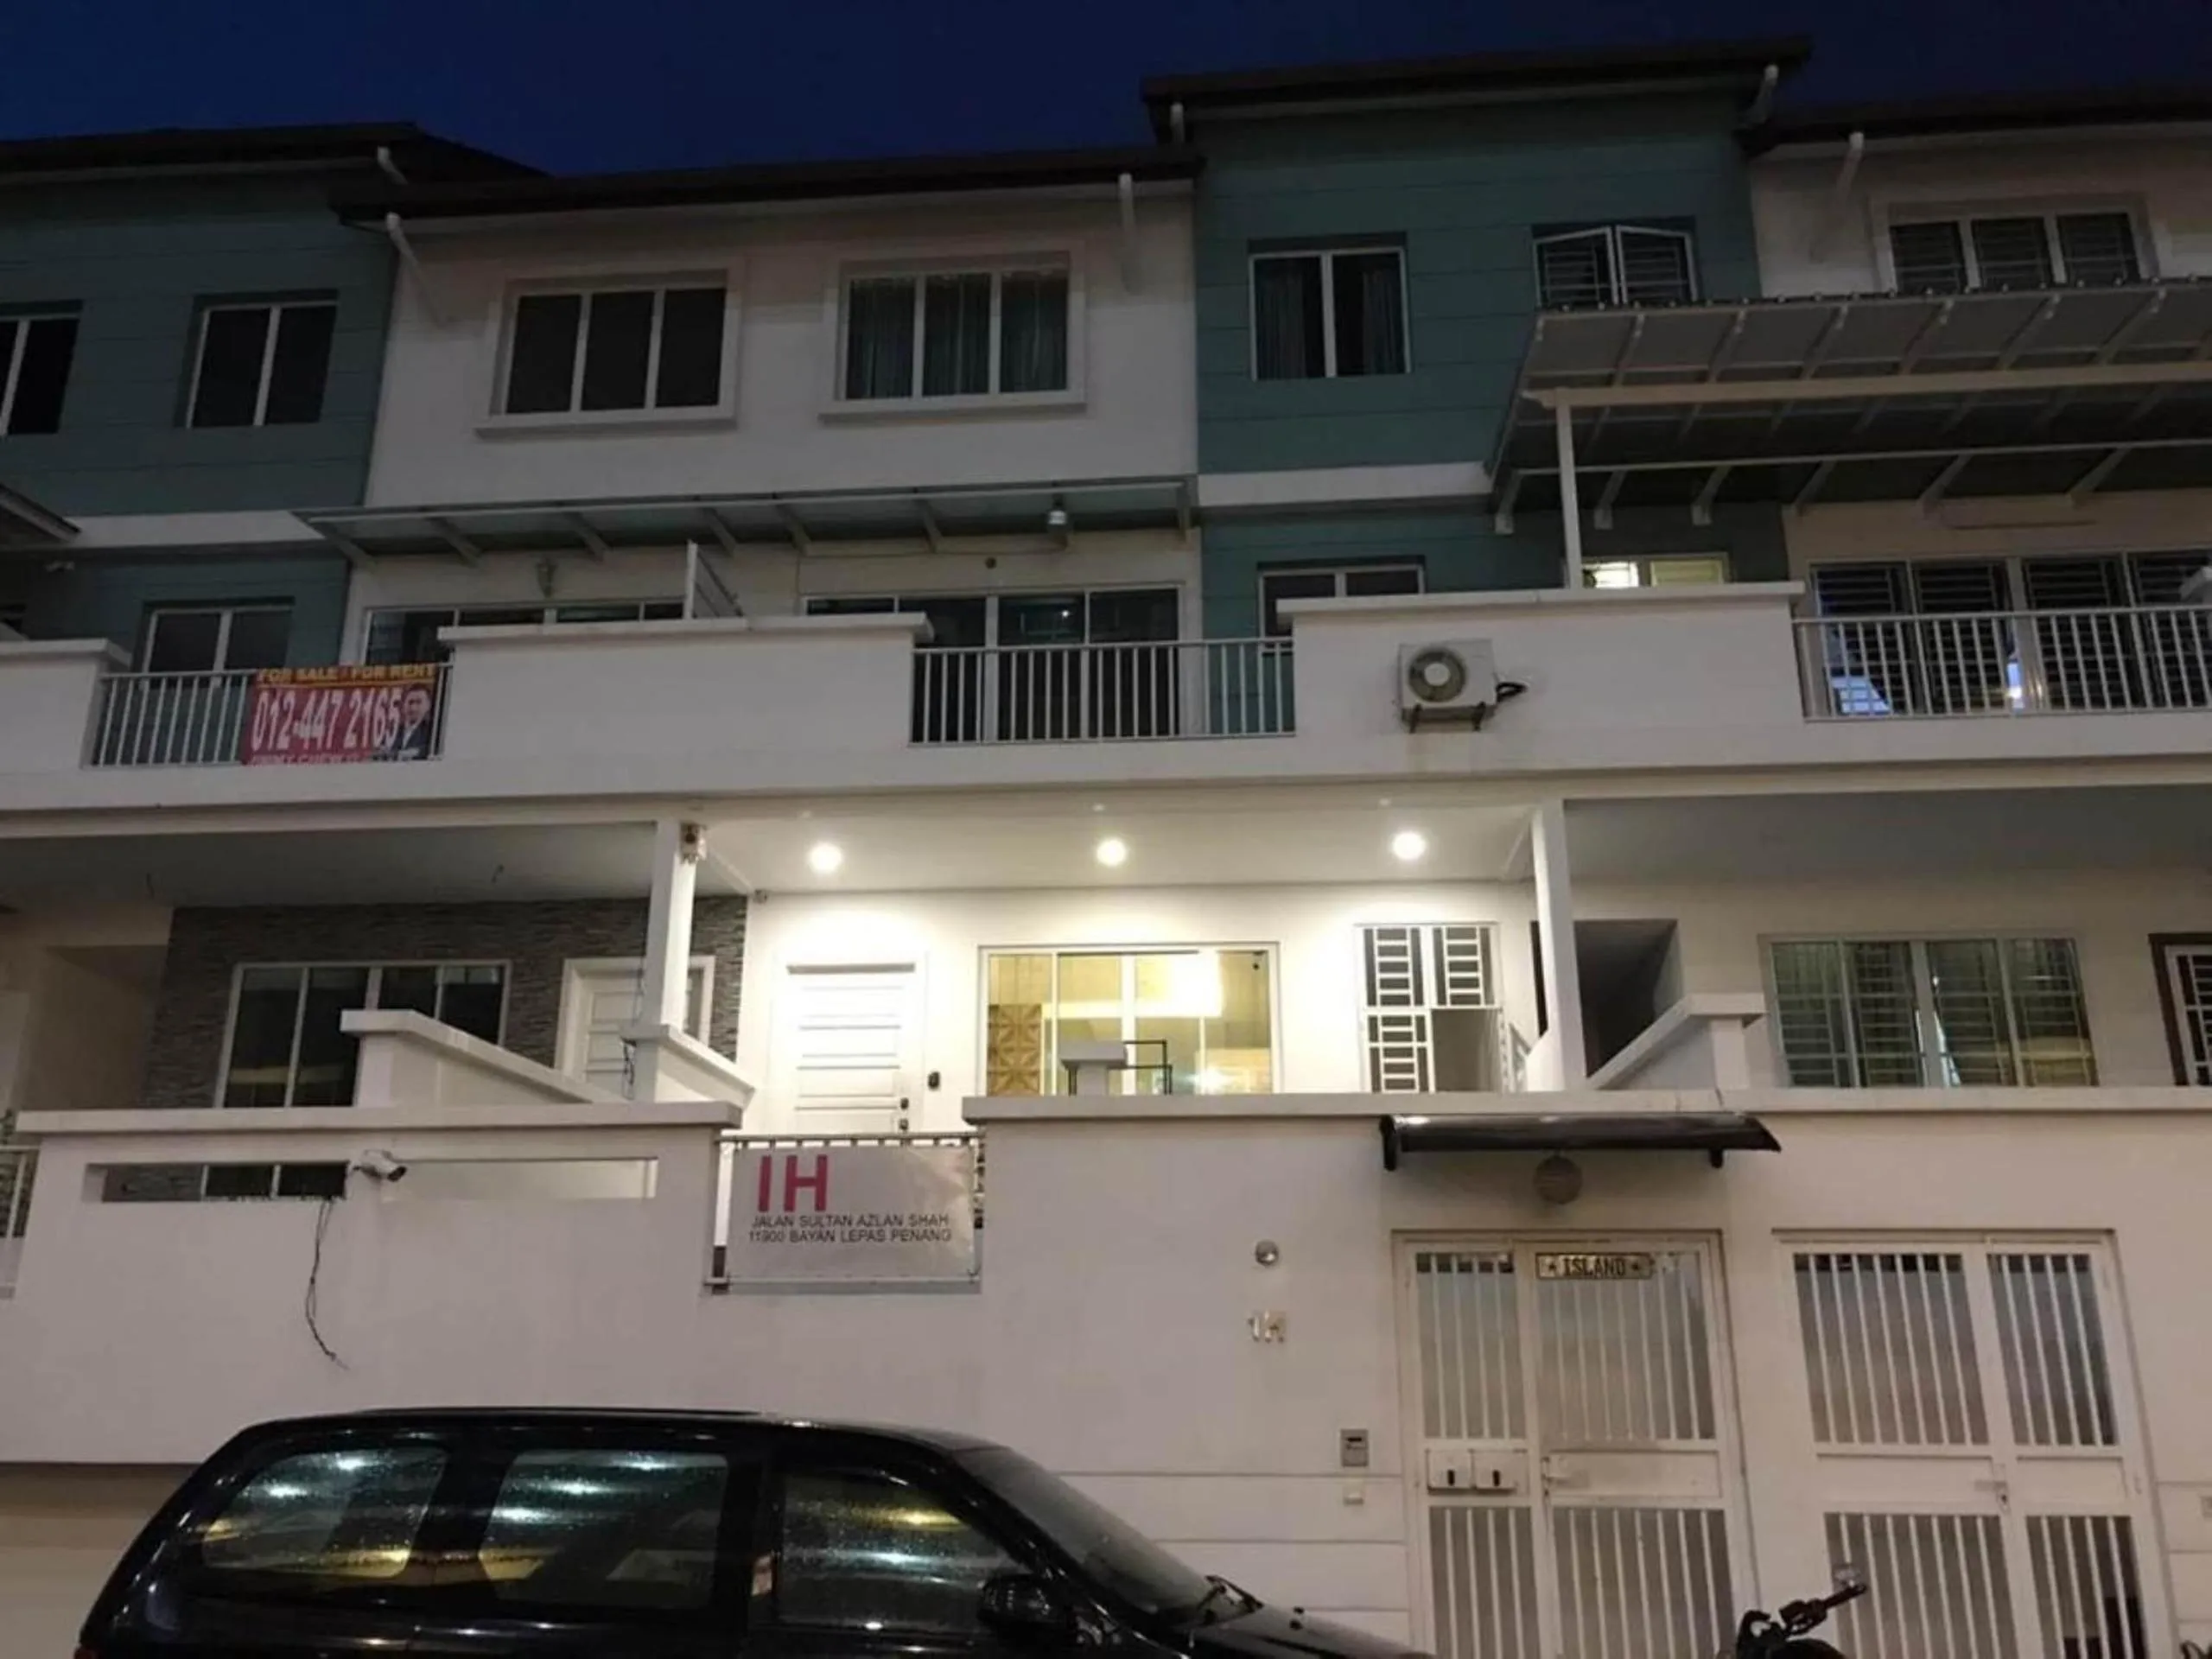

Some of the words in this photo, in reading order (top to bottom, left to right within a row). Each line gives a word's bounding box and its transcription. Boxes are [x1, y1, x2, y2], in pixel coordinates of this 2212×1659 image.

[258, 668, 292, 683] FOR
[296, 666, 338, 682] SALE
[352, 665, 385, 681] FOR
[251, 689, 346, 751] 012-447
[343, 687, 403, 750] 2165
[757, 1154, 828, 1211] IH
[751, 1214, 793, 1228] JALAN
[798, 1213, 852, 1228] SULTAN
[855, 1213, 903, 1227] AZLAN
[908, 1213, 949, 1227] SHAH
[748, 1230, 785, 1243] 11900
[789, 1230, 836, 1243] BAYAN
[840, 1229, 887, 1243] LEPAS
[891, 1229, 952, 1242] PENANG
[1563, 1257, 1626, 1277] ISLAND
